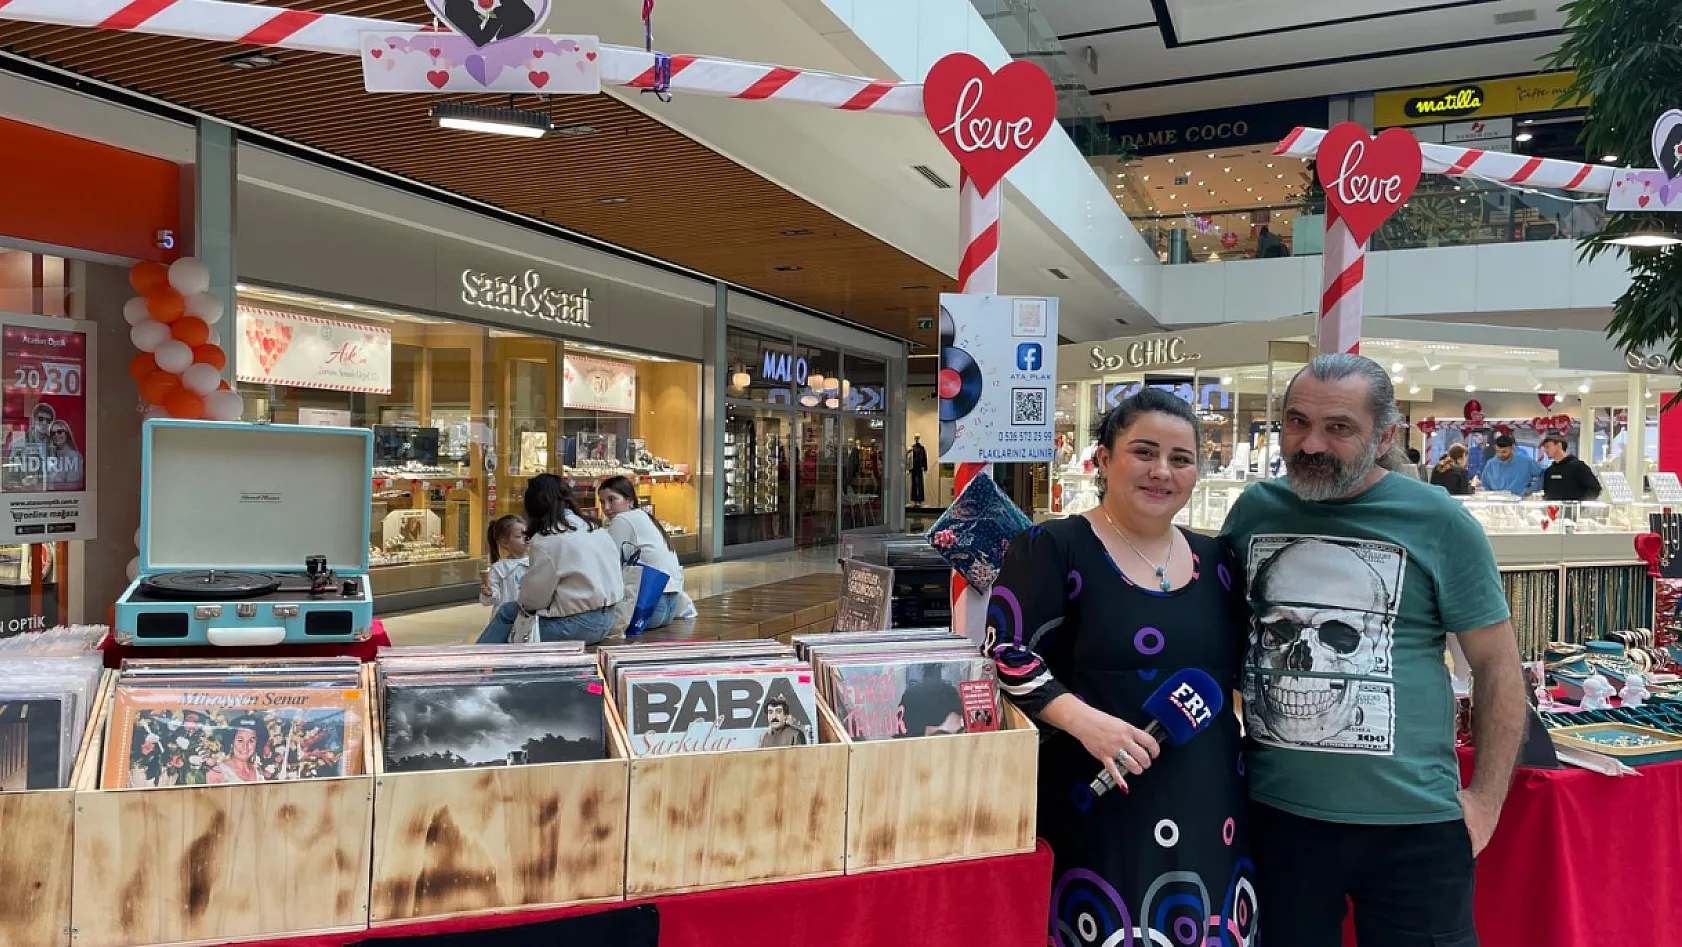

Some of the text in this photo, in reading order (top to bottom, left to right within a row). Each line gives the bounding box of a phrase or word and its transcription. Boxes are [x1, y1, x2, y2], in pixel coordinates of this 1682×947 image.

[1415, 89, 1482, 113] matilla
[938, 77, 1034, 152] love
[1120, 120, 1249, 147] DAME COCO
[1326, 140, 1402, 204] love
[157, 229, 174, 249] 5
[1090, 345, 1123, 371] So
[15, 368, 80, 394] 20 30
[998, 431, 1004, 442] 0
[24, 510, 48, 519] online
[9, 614, 46, 631] OPTİK
[183, 692, 309, 709] Müzeyyen Senar
[633, 677, 813, 735] BABA
[1357, 733, 1386, 743] 100
